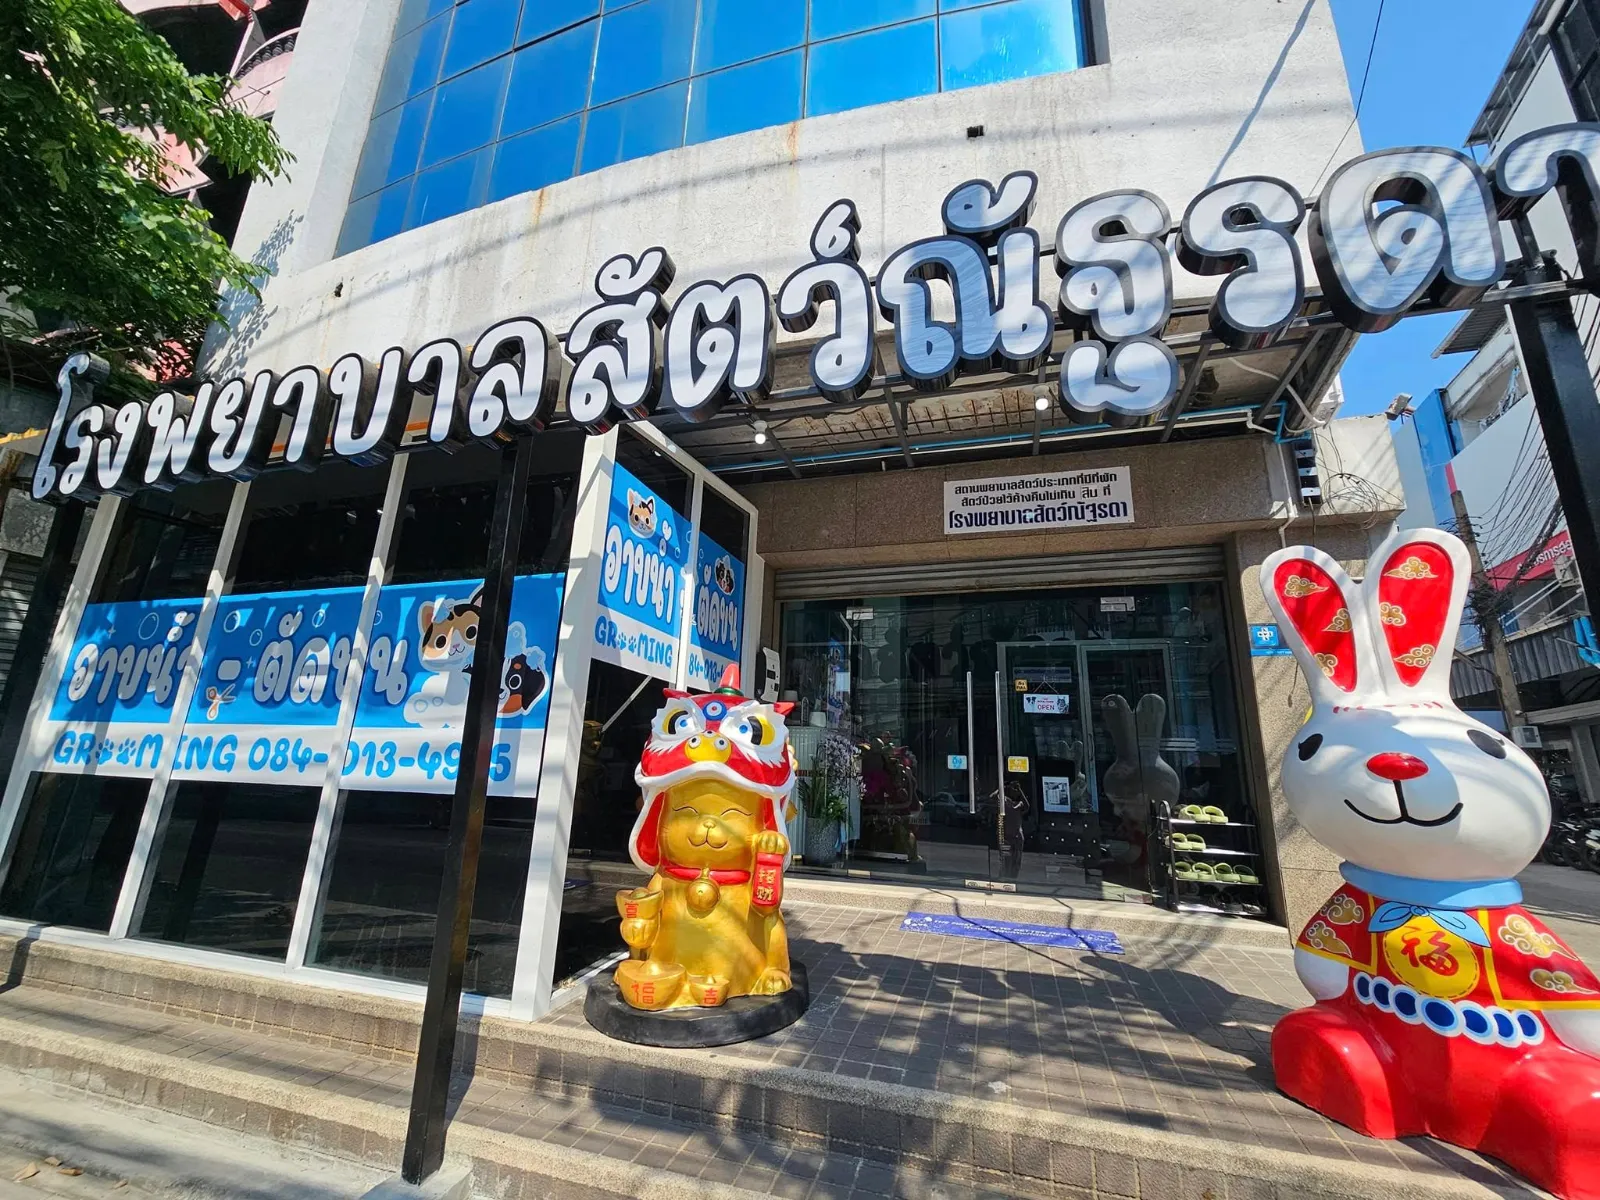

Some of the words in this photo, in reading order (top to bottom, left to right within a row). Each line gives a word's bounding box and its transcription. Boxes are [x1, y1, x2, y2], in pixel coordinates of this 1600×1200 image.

[247, 736, 512, 782] 084-013-495
[1400, 924, 1460, 977] 福
[631, 981, 656, 1005] 福
[703, 987, 719, 1005] 吉
